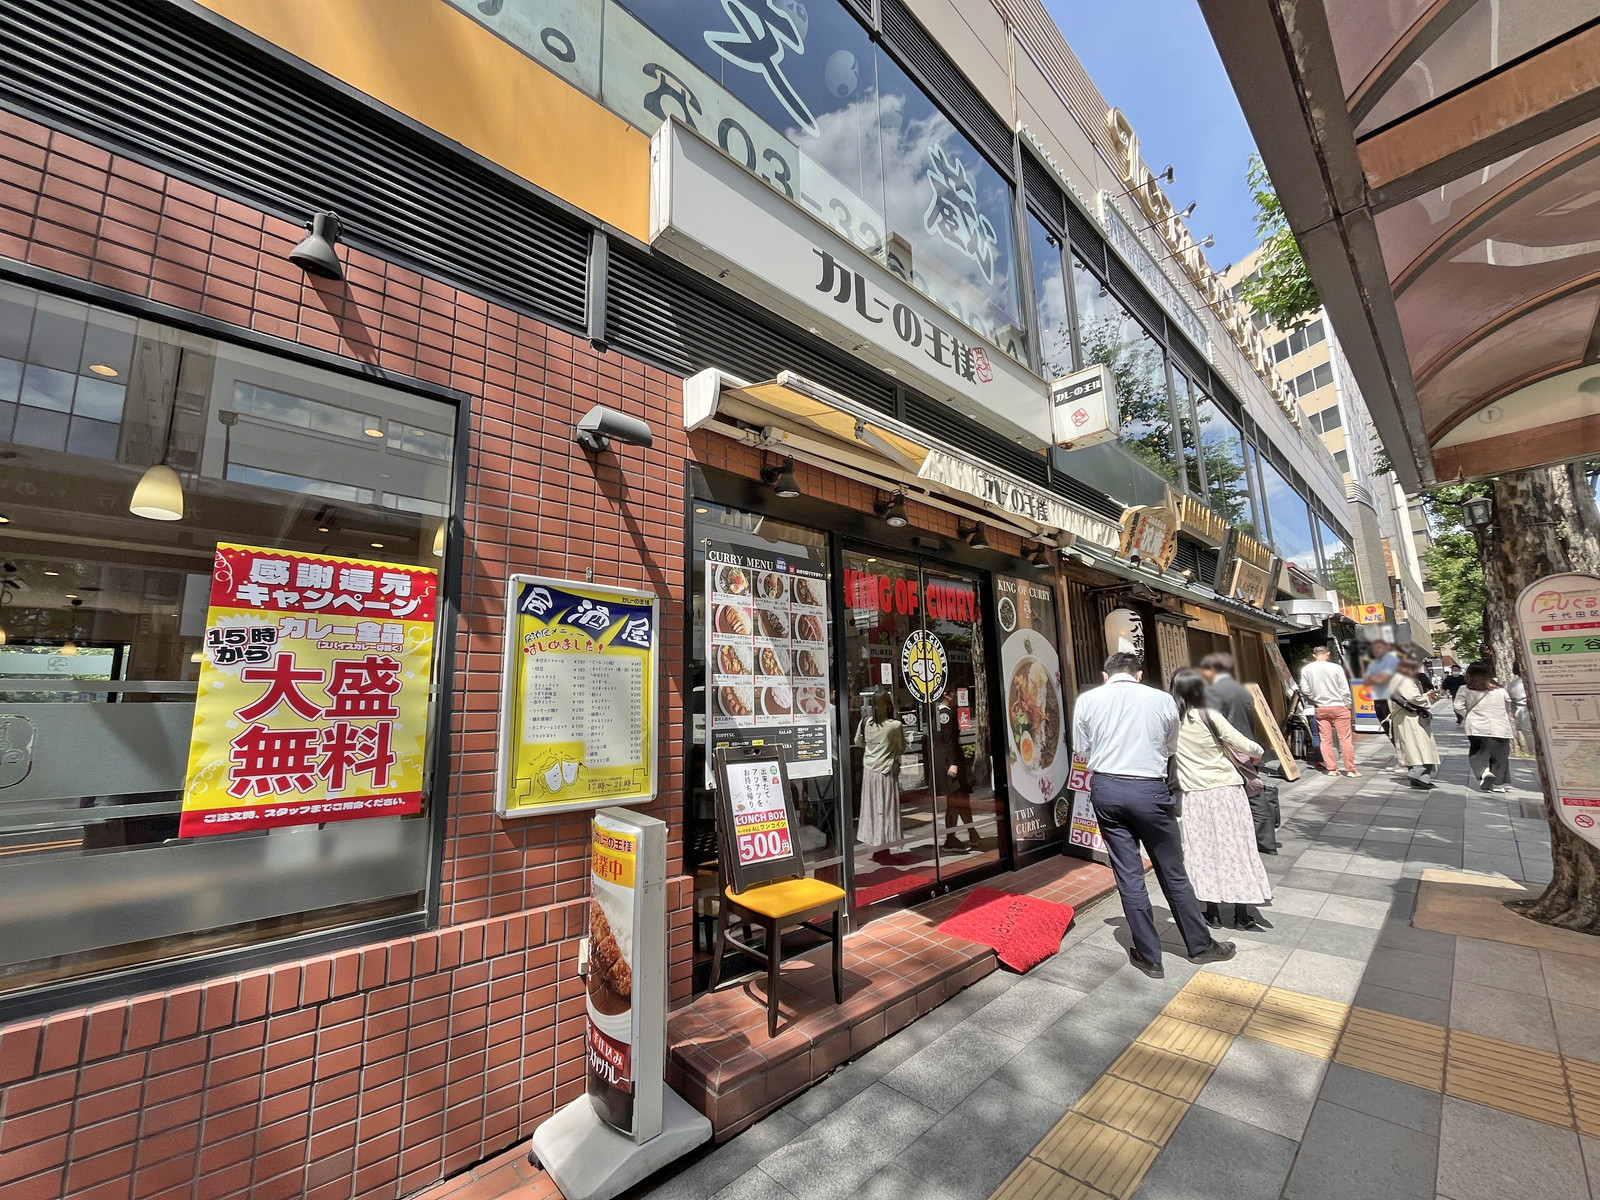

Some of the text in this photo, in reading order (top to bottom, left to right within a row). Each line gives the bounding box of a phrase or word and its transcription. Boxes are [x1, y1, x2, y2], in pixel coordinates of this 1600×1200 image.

[812, 248, 977, 385] カレーの王様
[1054, 379, 1102, 403] カレーの王様
[979, 474, 1048, 521] カレーの王様
[709, 550, 774, 571] CURRY MENU
[249, 558, 411, 597] 感謝還元
[997, 579, 1051, 602] KING OF CURRY
[236, 584, 419, 617] キャンペーン
[843, 568, 975, 623] KING OF CURRY
[208, 628, 277, 646] 15時
[279, 617, 404, 644] カレー全品
[216, 646, 271, 664] から
[903, 640, 913, 673] KING
[913, 632, 923, 641] OF
[236, 653, 400, 721] 大盛
[229, 722, 396, 797] 無料
[735, 811, 786, 826] LUNCH BOX
[1015, 807, 1035, 821] TWIN
